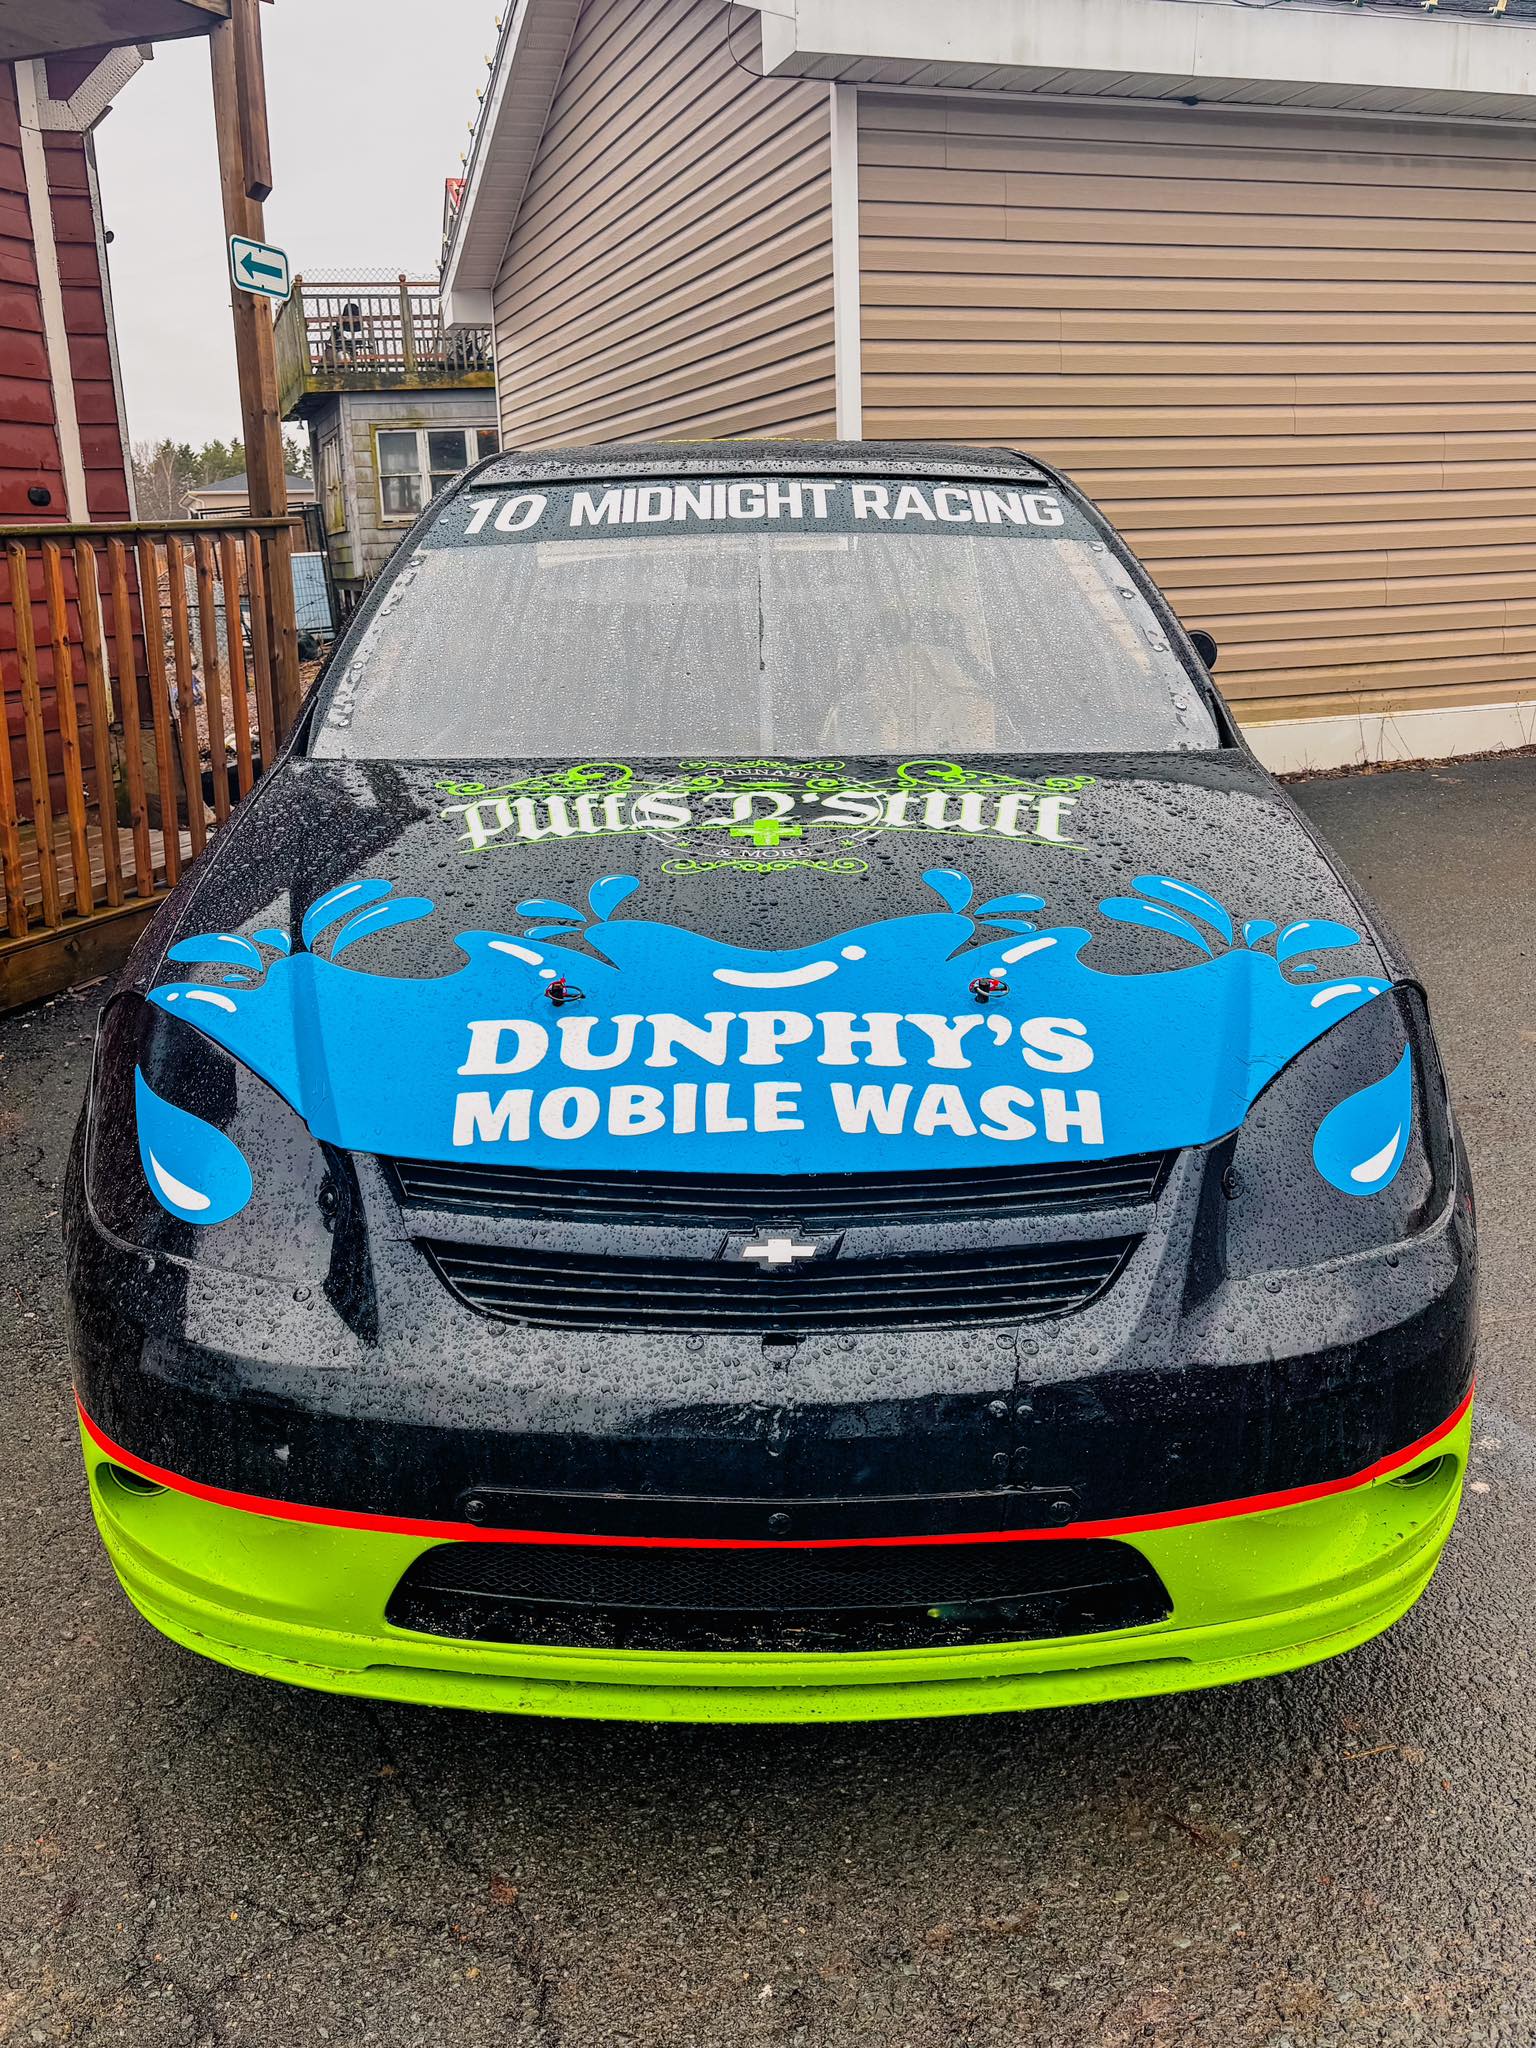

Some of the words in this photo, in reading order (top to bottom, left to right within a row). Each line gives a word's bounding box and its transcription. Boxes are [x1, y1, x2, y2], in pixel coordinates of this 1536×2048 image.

[464, 494, 548, 535] 10
[569, 483, 836, 527] MIDNIGHT
[851, 484, 1065, 527] RACING
[704, 768, 820, 779] CANNABIS
[717, 848, 733, 857] &
[740, 847, 813, 857] MORE
[457, 1011, 1094, 1076] DUNPHY'S
[453, 1082, 805, 1146] MOBILE
[830, 1082, 1105, 1145] WASH
